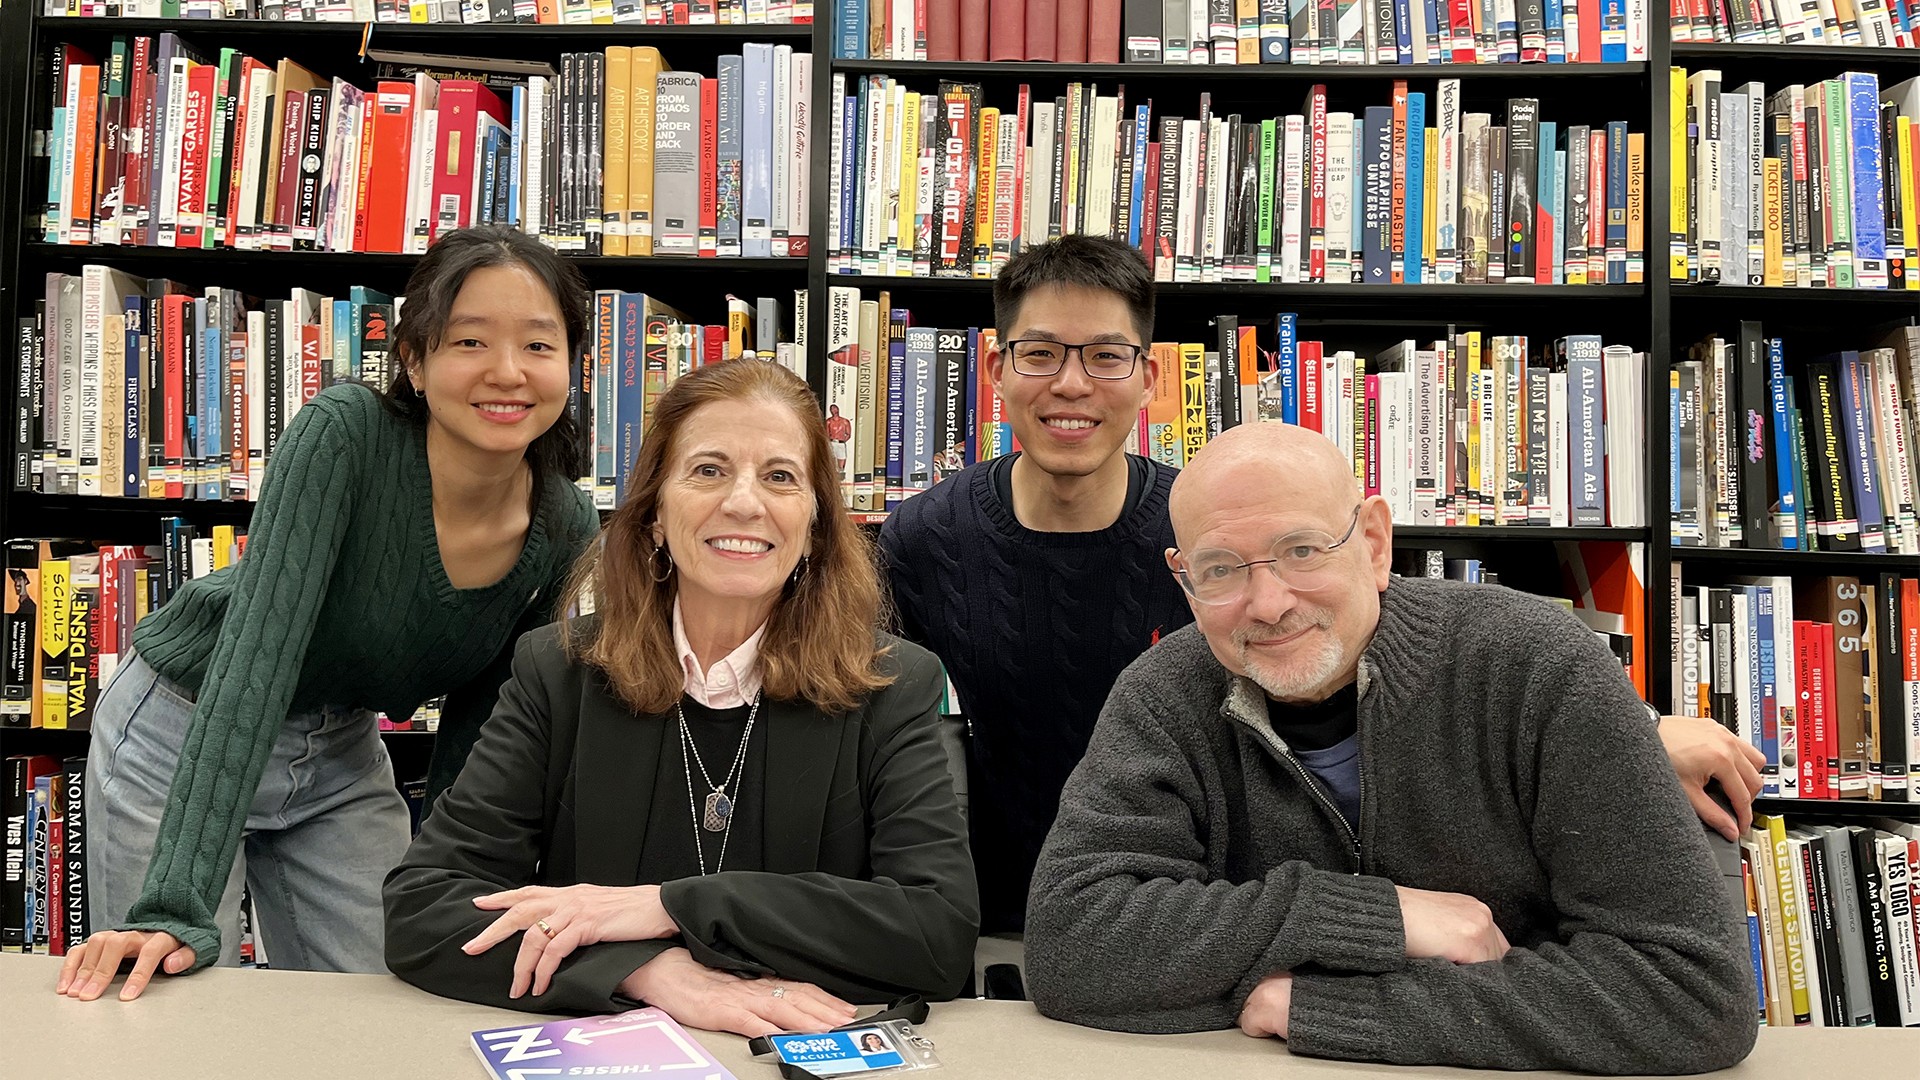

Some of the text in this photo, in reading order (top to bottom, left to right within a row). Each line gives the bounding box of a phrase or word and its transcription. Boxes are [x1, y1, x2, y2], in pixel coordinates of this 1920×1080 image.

[112, 55, 123, 82] OBEY
[656, 77, 697, 87] FABRICA
[657, 87, 665, 95] 10
[757, 80, 767, 96] hfg
[226, 96, 237, 121] OCTET
[656, 95, 684, 103] FROM
[656, 104, 690, 113] CHAOS
[656, 113, 668, 121] TO
[656, 122, 691, 131] ORDER
[720, 64, 732, 144] American Art
[1071, 87, 1080, 152] CARCHITECTURE
[1512, 105, 1535, 114] Podaj
[1831, 85, 1841, 127] TYPOGRAPHY
[143, 99, 151, 159] POSTCARDS
[179, 91, 200, 212] AVANT-GARDES
[288, 102, 301, 157] Floating Worlds
[303, 95, 322, 206] CHIP KIDD BOOK
[655, 132, 676, 140] AND
[655, 140, 681, 149] BACK
[794, 102, 806, 159] Woody Guthrie
[870, 101, 880, 182] LABELING AMERICA
[906, 101, 914, 156] FINGERPRINT
[1135, 114, 1145, 172] OPEN HERE
[1163, 120, 1178, 160] BURNING
[1313, 94, 1325, 198] STICKY GRAPHICS
[1410, 101, 1420, 169] ARCHIPELAGO
[1709, 98, 1721, 191] motion graphics
[1751, 97, 1763, 176] flatnessisgod
[704, 172, 712, 213] PICTURES
[940, 103, 965, 259] EIGHTBALL
[979, 114, 993, 224] VIETNAM POSTERS
[1366, 163, 1378, 228] UNIVERSE
[1379, 126, 1391, 219] TYPOGRAPHIC
[1393, 120, 1405, 252] FANTASTIC PLASTIC
[1631, 154, 1644, 186] make
[1767, 163, 1778, 230] TICKETY-BOO
[994, 170, 1011, 240] IMAGE MAKERS
[1118, 174, 1130, 234] BURNING HOUSE
[1159, 212, 1173, 237] HAUS
[1161, 192, 1174, 210] THE
[1627, 187, 1639, 221] space
[600, 296, 612, 366] BAUHAUS
[908, 341, 934, 349] -1919
[909, 333, 934, 341] 1900
[1226, 330, 1234, 376] morandini
[1572, 341, 1599, 349] 1900
[20, 327, 31, 398] NYC STOREFRONTS
[61, 318, 73, 446] Hannsjörg Voth 1973 2003
[83, 332, 99, 409] WEAPONS MASS
[859, 350, 871, 410] ADVERTISING
[1185, 351, 1201, 381] IDEA
[1305, 359, 1317, 414] $ELLEBRITY
[1343, 378, 1351, 399] BUZZ
[1532, 374, 1547, 405] JUST
[128, 377, 138, 439] FIRST CLASS
[914, 358, 928, 456] All-American
[946, 360, 959, 458] All-American
[1419, 362, 1430, 476] The Advertising Concept
[1483, 384, 1492, 421] BIG LIFE
[1890, 383, 1903, 453] SHIGEO FUKUDA
[889, 412, 902, 461] American Woman
[1163, 424, 1173, 456] COLD
[1532, 441, 1547, 476] TYPE
[1582, 367, 1596, 502] All-American Ads
[1800, 447, 1809, 471] VEGAS
[52, 573, 65, 642] SCHULZ
[69, 586, 88, 718] WALT DISNEY
[89, 608, 100, 679] NEAL GABLER
[1751, 702, 1761, 734] DESIGN
[1813, 693, 1823, 742] SCHOOL READER
[1910, 712, 1920, 736] Signs
[1784, 779, 1796, 788] K
[7, 815, 24, 845] Yves
[69, 773, 82, 854] NORMAN
[6, 849, 23, 881] Klein
[35, 819, 48, 935] CENTURY GIRL
[1775, 841, 1798, 919] GENIUS
[1888, 852, 1909, 917] YES LOGO
[1845, 888, 1856, 932] Excellence
[1867, 880, 1888, 980] AM PLASTIC, TOO
[569, 1065, 652, 1076] THESES
[792, 1051, 846, 1061] FACULTY
